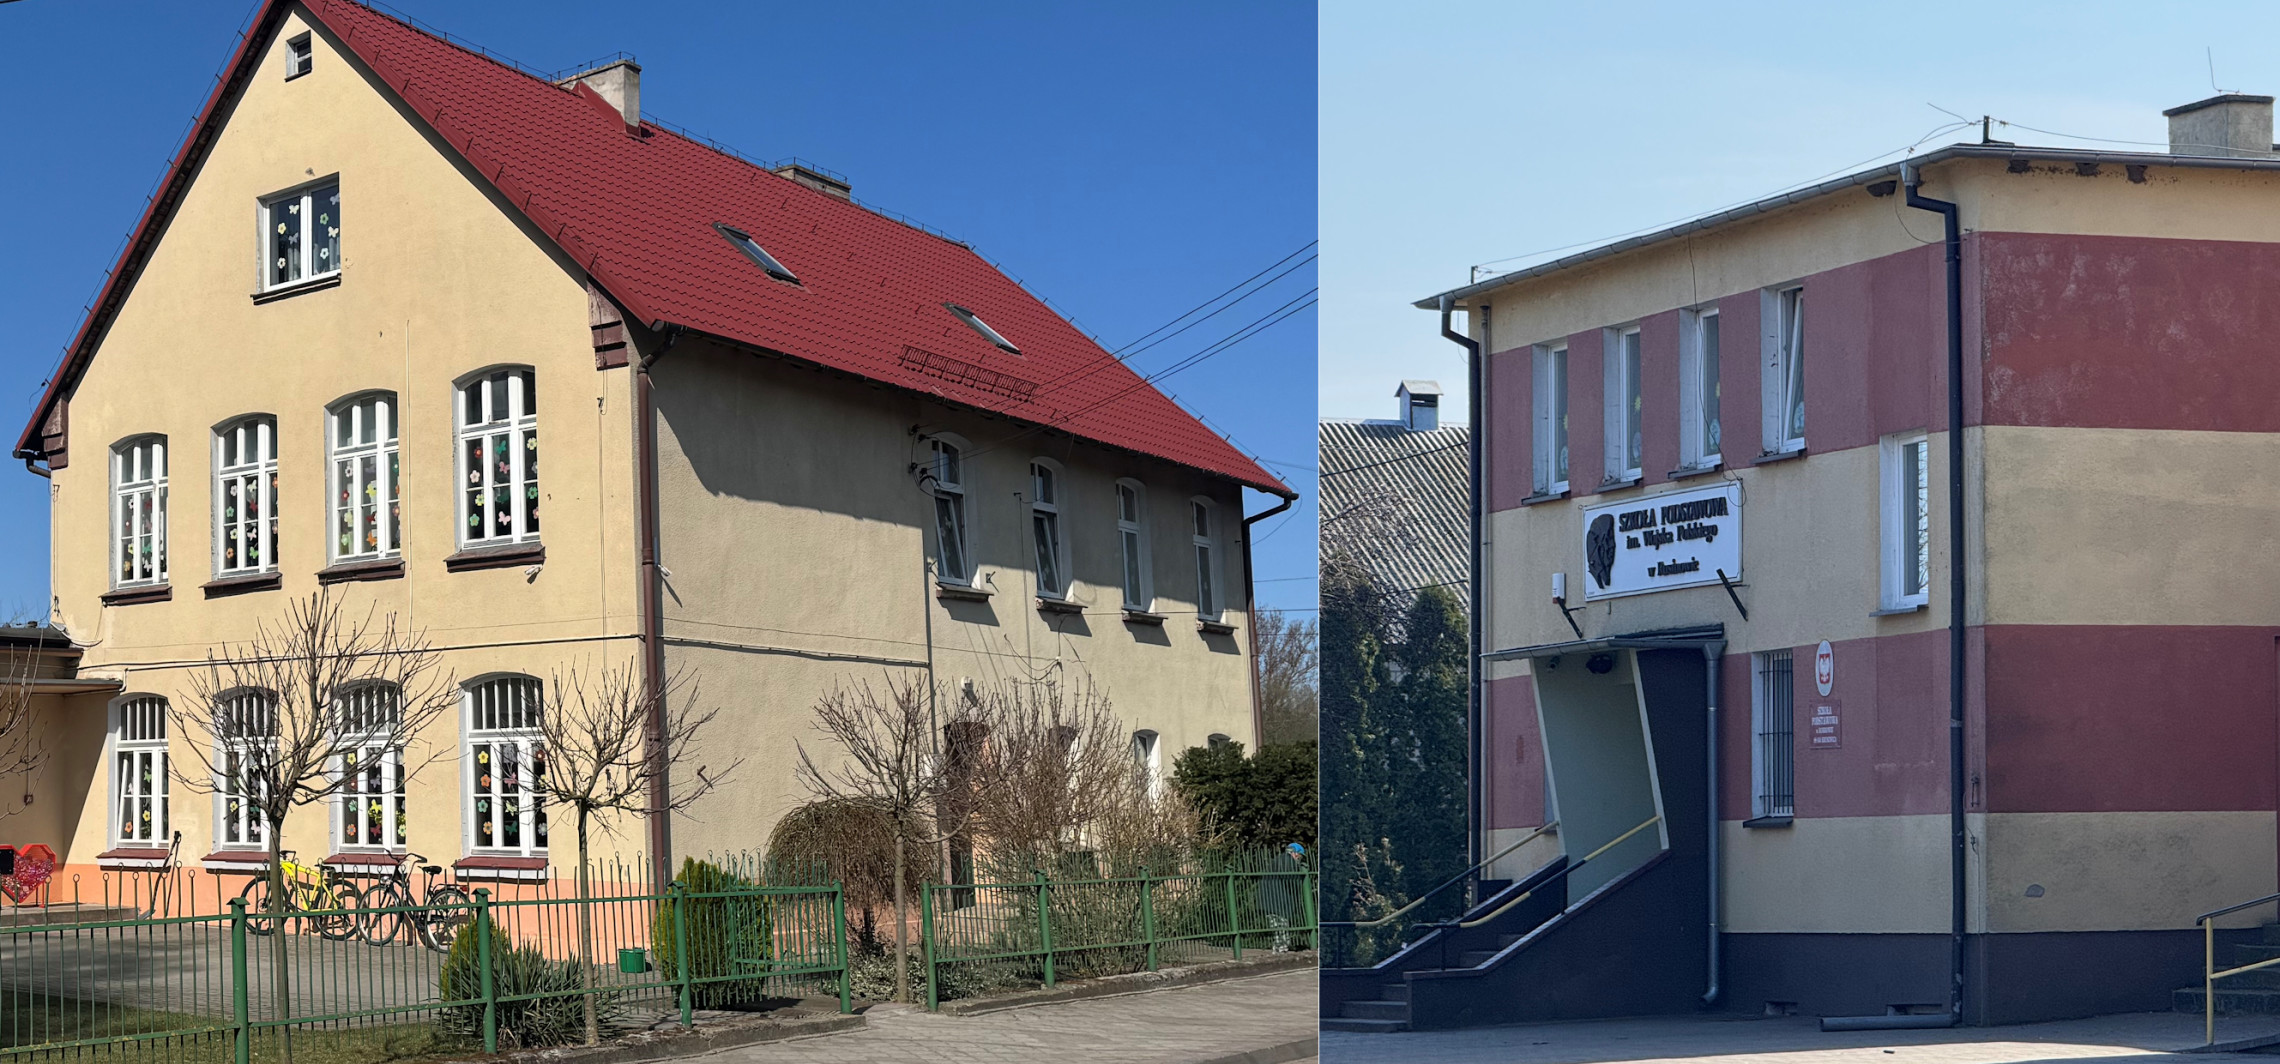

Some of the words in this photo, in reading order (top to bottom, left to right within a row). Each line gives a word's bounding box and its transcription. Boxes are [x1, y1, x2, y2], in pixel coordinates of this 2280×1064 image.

[1619, 508, 1657, 532] SZKOŁA
[1661, 497, 1729, 525] PODSTAWOWA
[1626, 535, 1641, 549] im.
[1643, 527, 1674, 550] Wojska
[1677, 522, 1718, 543] Polskiego
